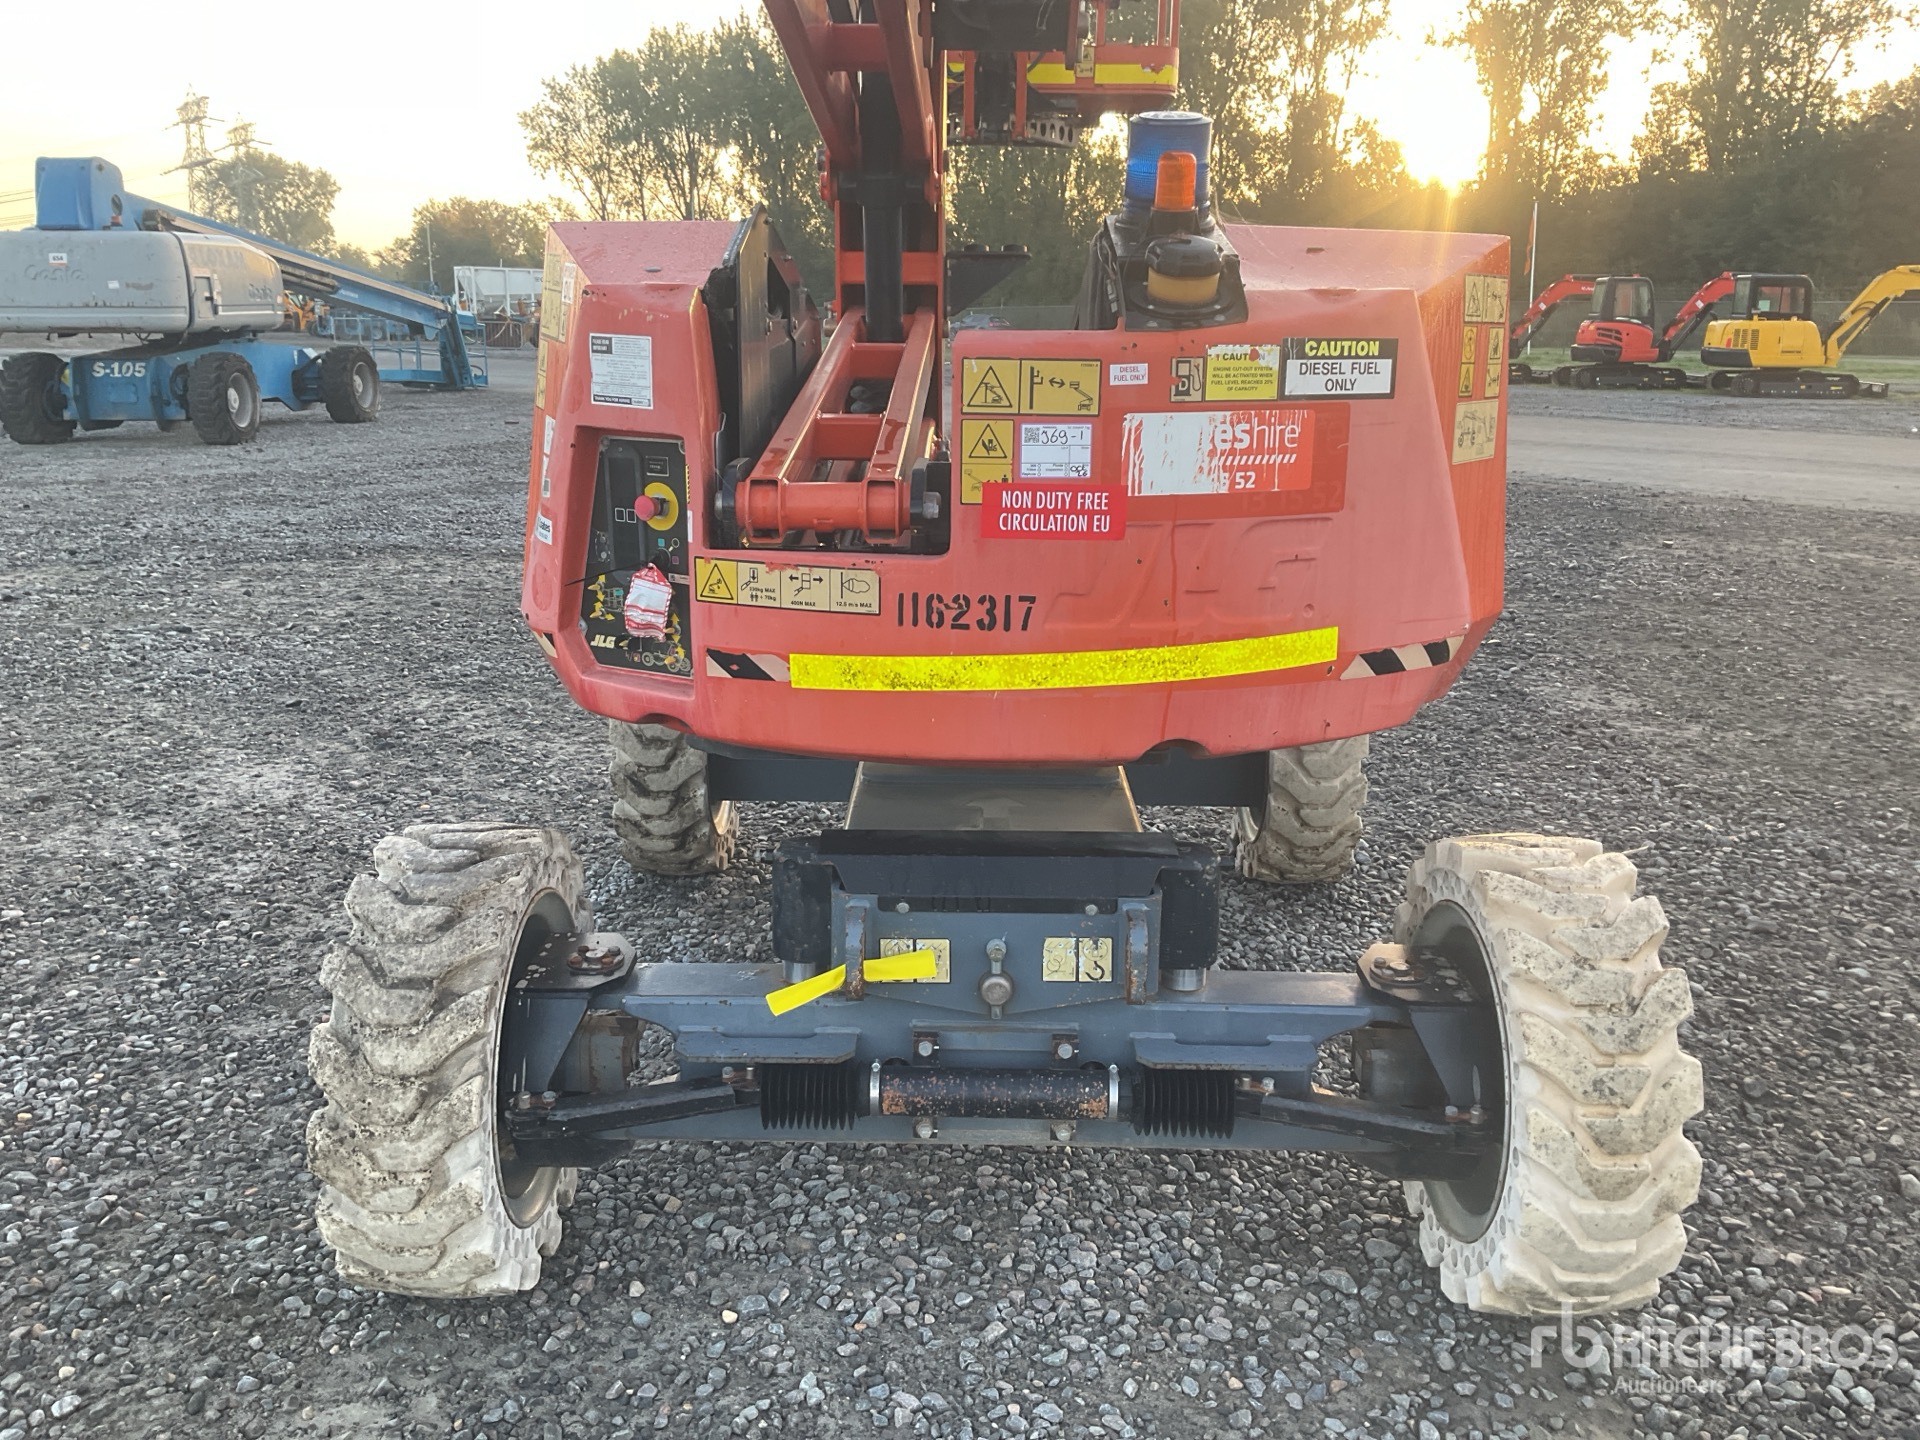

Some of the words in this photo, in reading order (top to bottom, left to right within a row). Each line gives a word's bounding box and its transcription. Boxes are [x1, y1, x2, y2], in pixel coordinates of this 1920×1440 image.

[1305, 340, 1380, 356] CAUTION
[1222, 352, 1265, 361] CAUTN
[92, 361, 146, 378] S-105
[1299, 362, 1346, 375] DIESEL
[1351, 361, 1380, 375] FUEL
[1324, 378, 1357, 392] ONLY
[1234, 471, 1256, 489] 52
[1002, 490, 1032, 509] NON
[1036, 491, 1072, 509] DUTY
[1077, 492, 1109, 510] FREE
[999, 513, 1088, 532] CIRCULATION
[1093, 515, 1110, 532] EU
[898, 592, 1036, 632] 1162317
[590, 634, 616, 649] JLG
